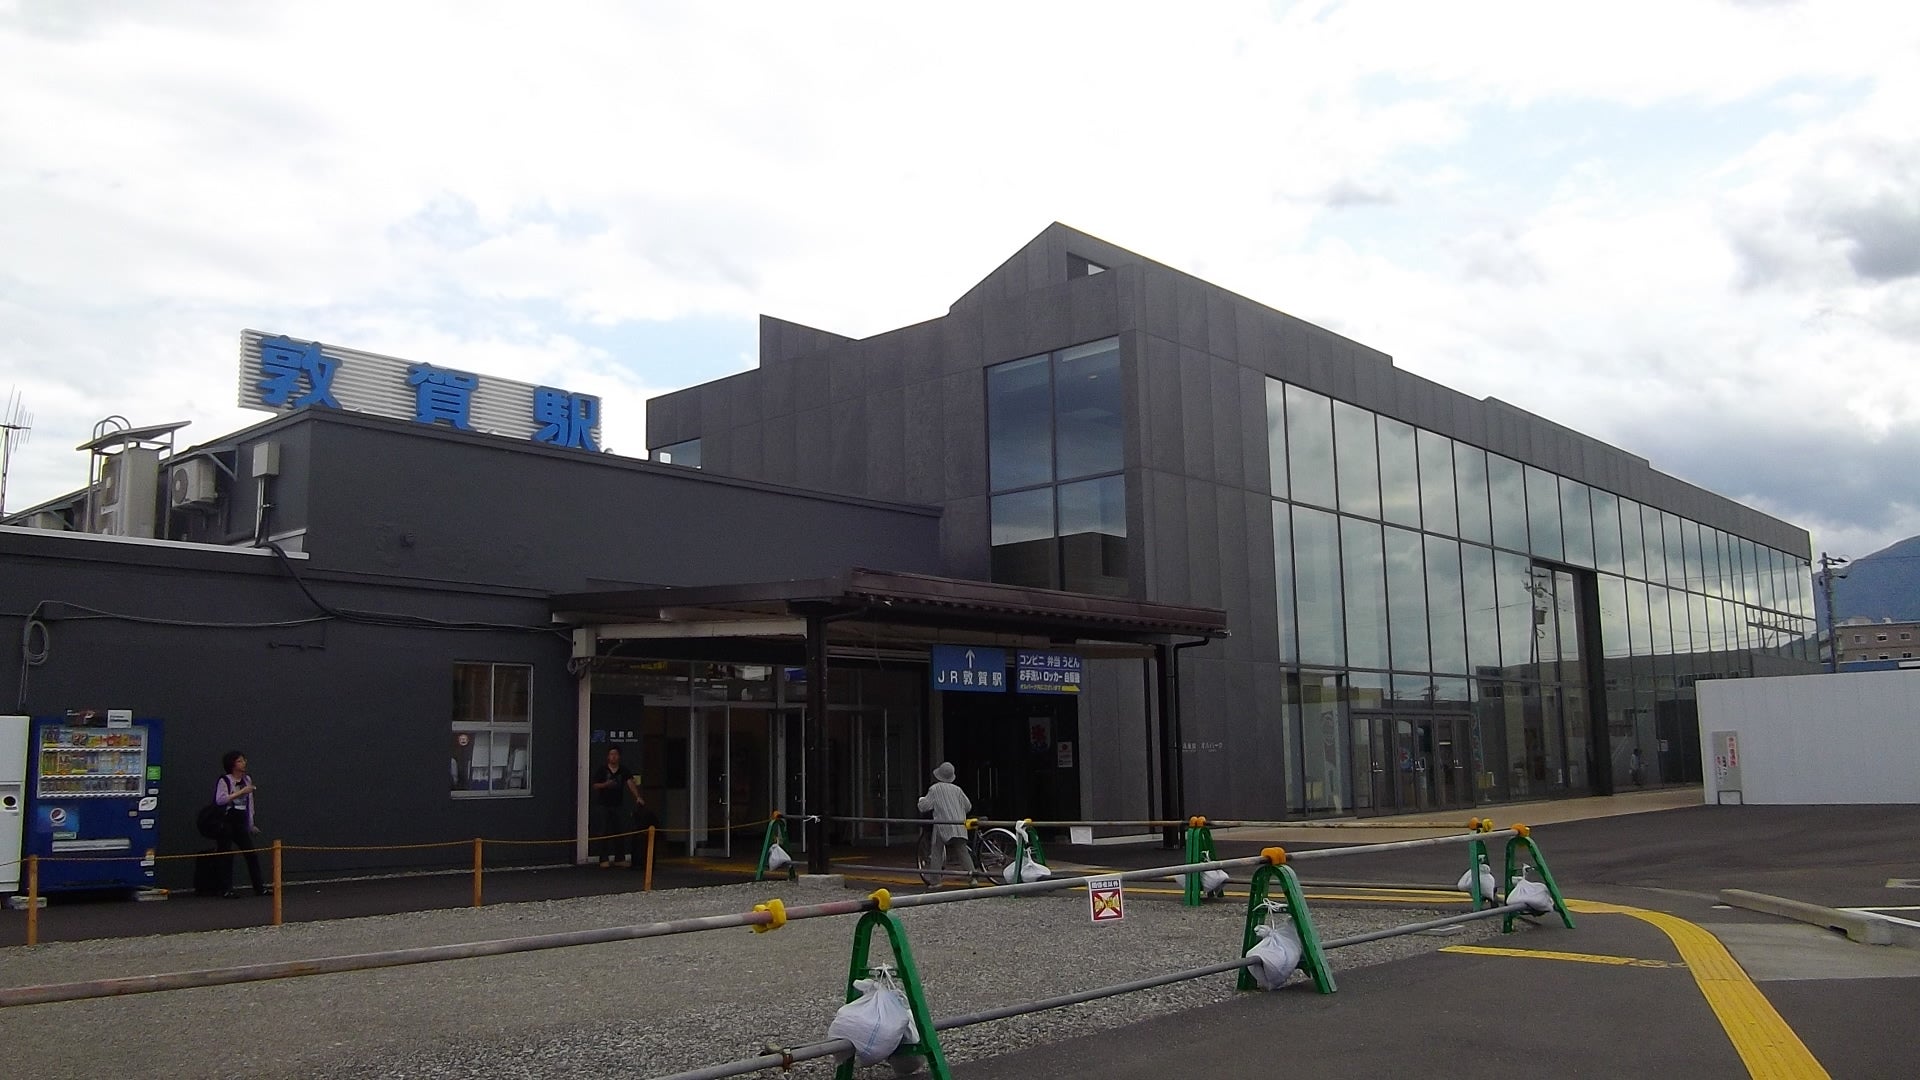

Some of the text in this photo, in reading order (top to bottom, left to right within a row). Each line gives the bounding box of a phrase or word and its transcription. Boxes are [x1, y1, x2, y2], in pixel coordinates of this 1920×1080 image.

[258, 334, 601, 453] 敦賀駅
[1019, 654, 1080, 668] コンビニ 弁当 うどん
[1019, 669, 1042, 682] お手洗い
[1043, 671, 1063, 683] ロッカー
